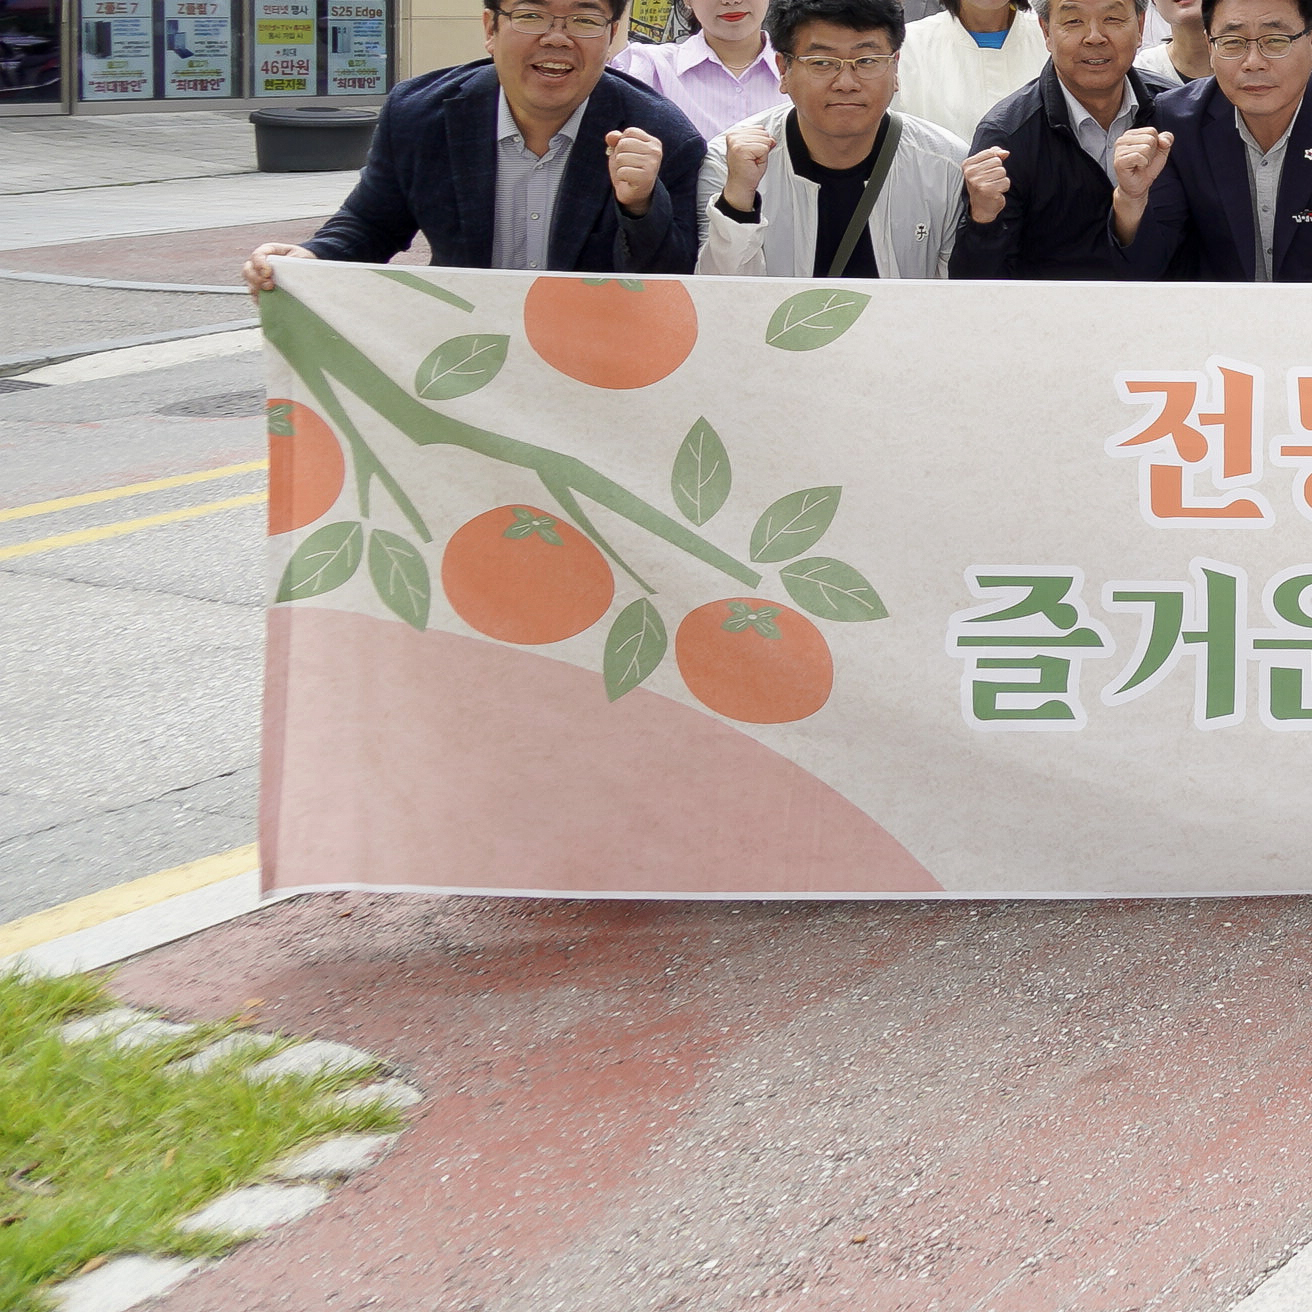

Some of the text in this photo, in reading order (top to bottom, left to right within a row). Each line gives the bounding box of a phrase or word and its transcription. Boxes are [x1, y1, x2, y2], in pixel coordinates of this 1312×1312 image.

[331, 6, 383, 18] S25 Edge
[260, 59, 310, 76] 46만원
